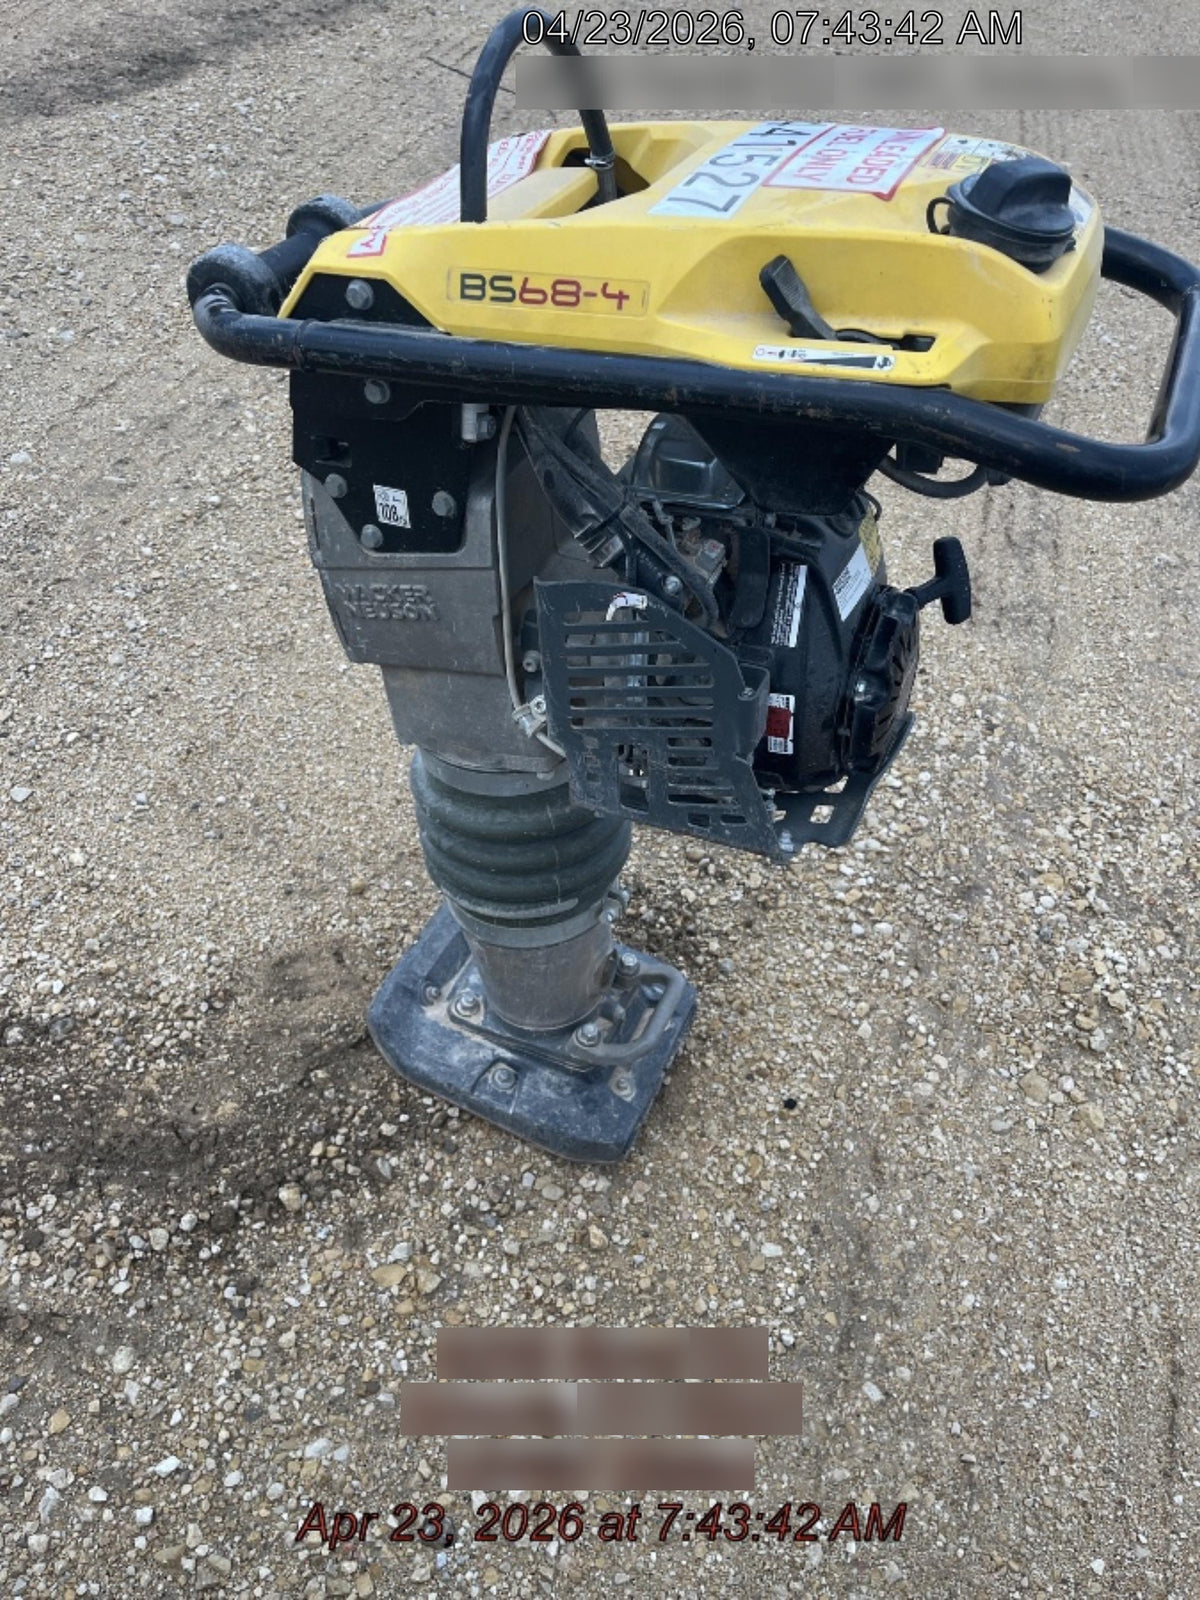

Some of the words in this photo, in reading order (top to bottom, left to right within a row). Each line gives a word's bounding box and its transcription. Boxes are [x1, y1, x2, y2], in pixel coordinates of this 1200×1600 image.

[667, 120, 811, 213] 41527
[460, 272, 630, 311] BS68-4
[334, 583, 433, 603] WACKER
